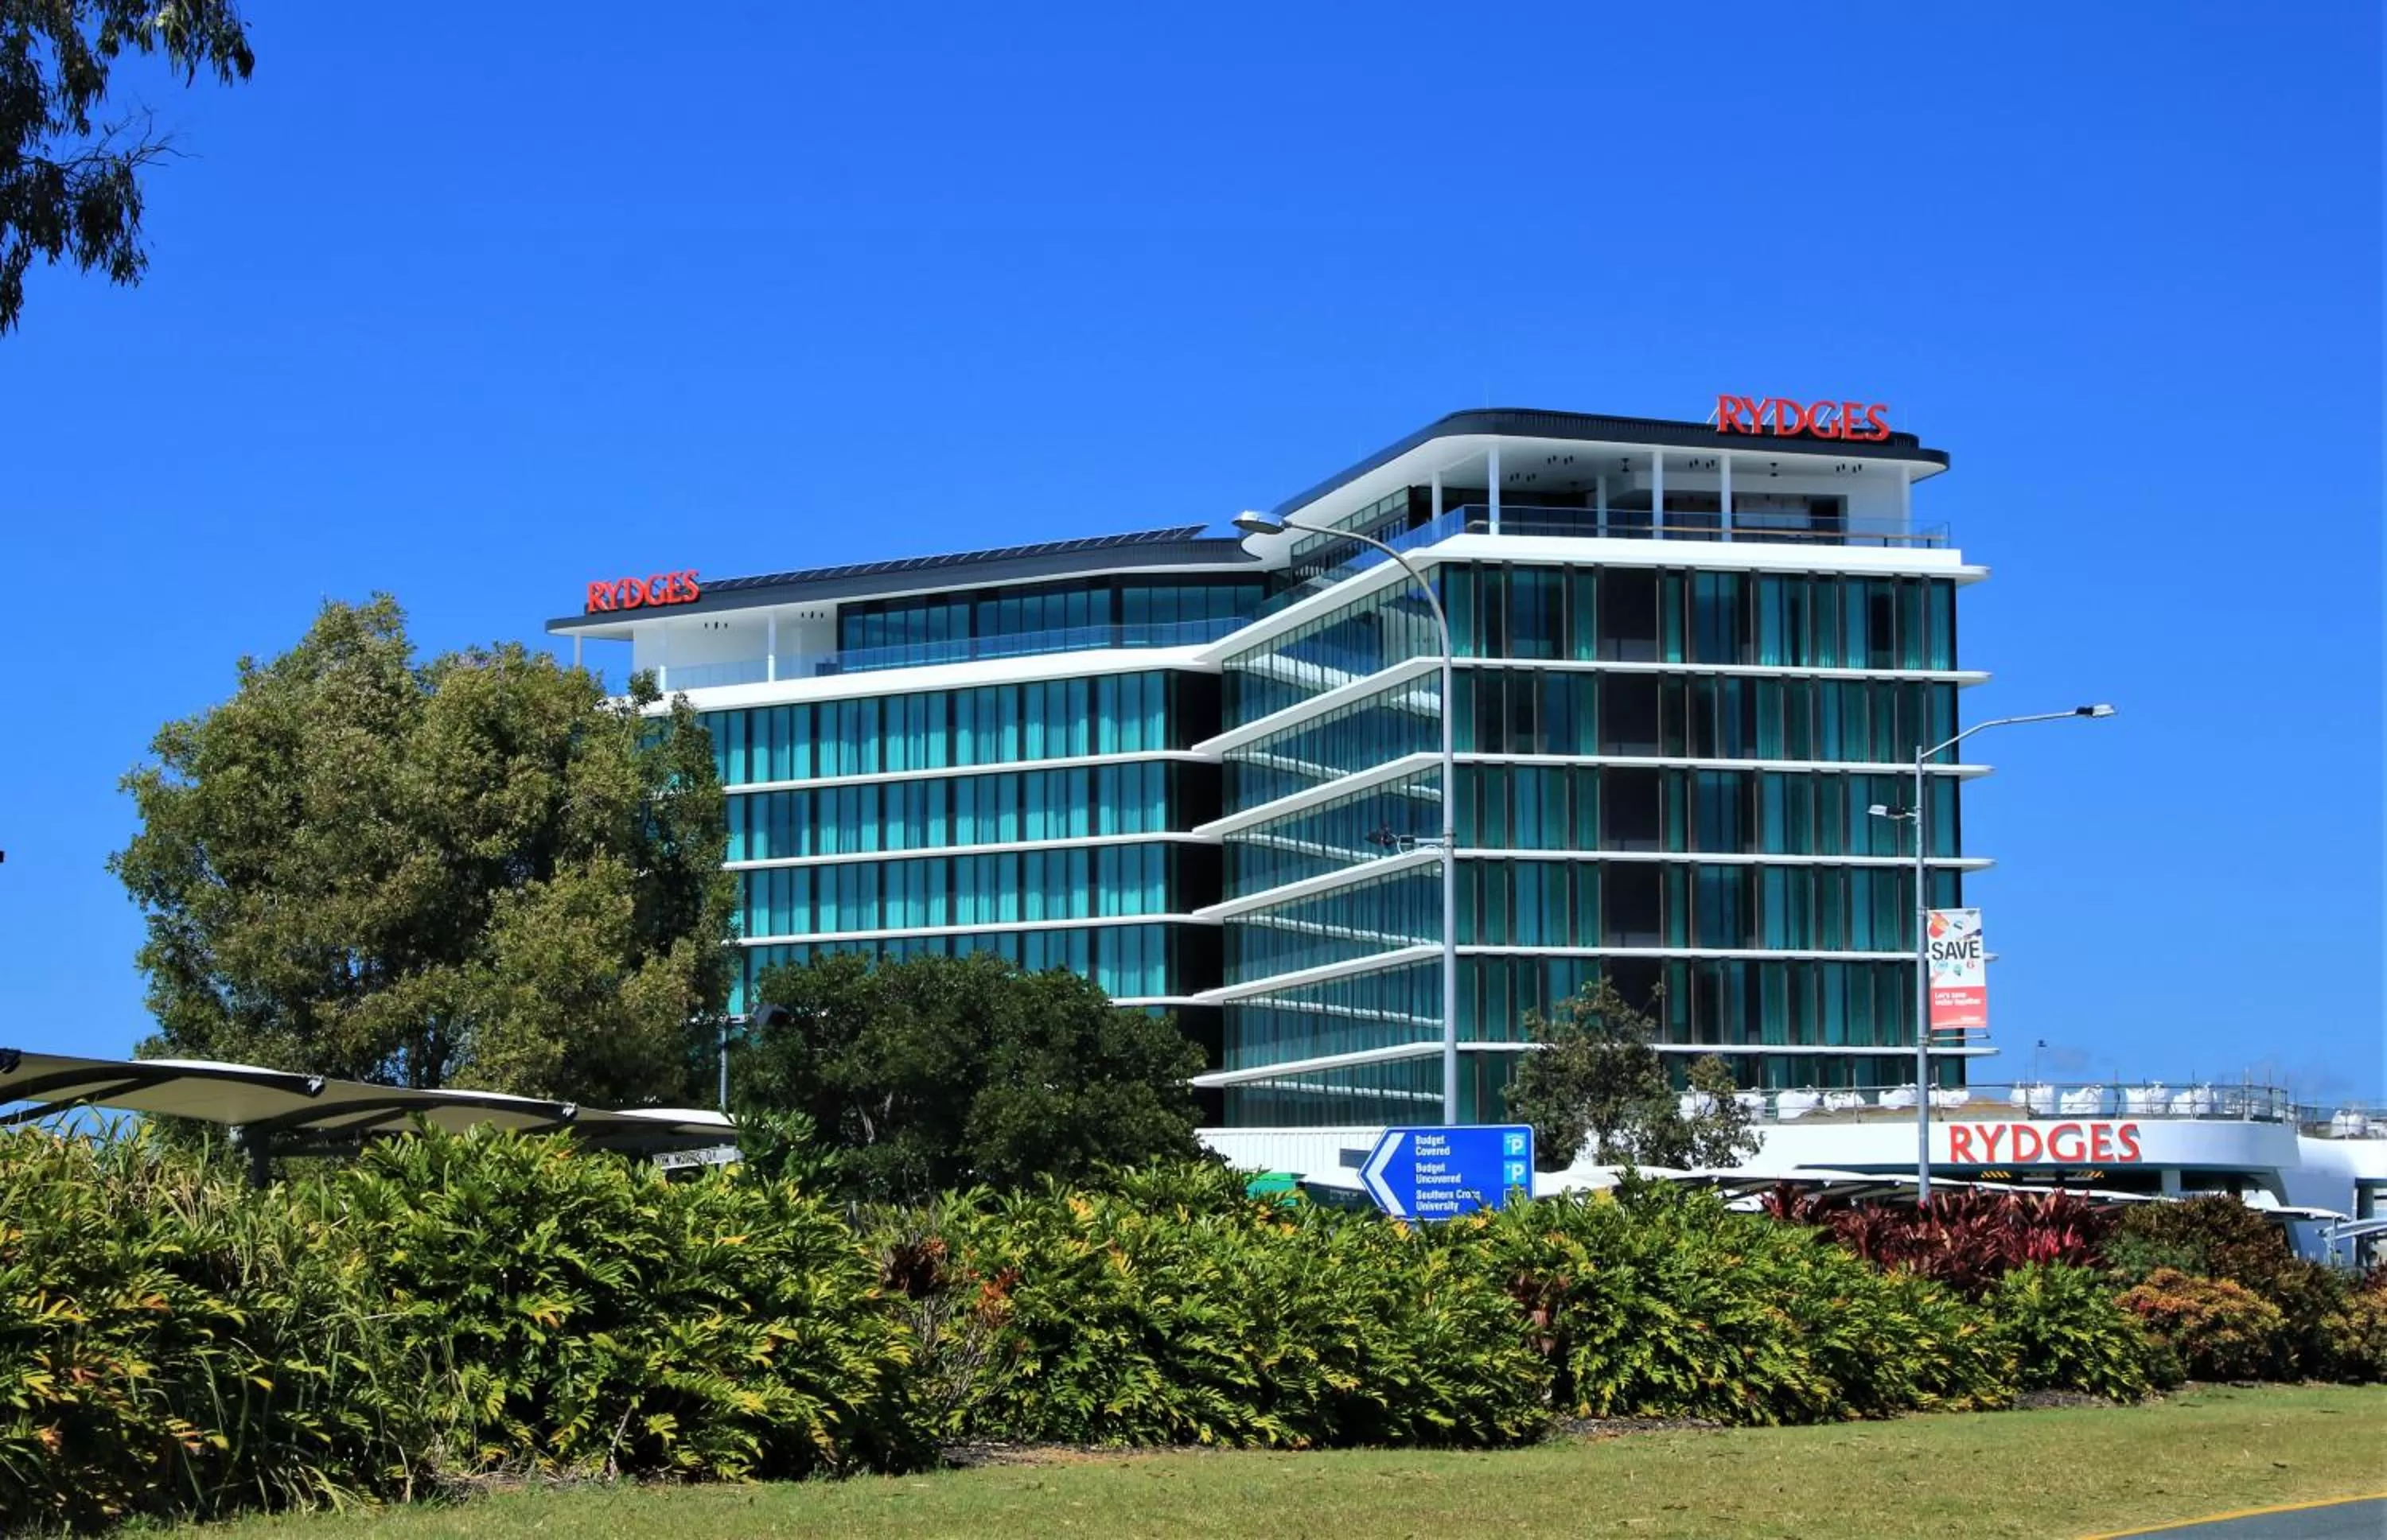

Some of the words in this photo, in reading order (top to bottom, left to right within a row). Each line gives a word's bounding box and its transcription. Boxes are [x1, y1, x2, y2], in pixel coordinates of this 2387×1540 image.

[1716, 395, 1891, 441] RYDGES
[587, 569, 701, 612] RYDGES
[1931, 940, 1980, 960] SAVE
[1415, 1135, 1445, 1146] Budget
[1949, 1123, 2141, 1164] RYDGES
[1415, 1146, 1451, 1156] Covered
[1415, 1162, 1446, 1174] Budget
[1415, 1172, 1462, 1184] Uncovered
[1415, 1189, 1454, 1200] Southern
[1415, 1200, 1459, 1212] University
